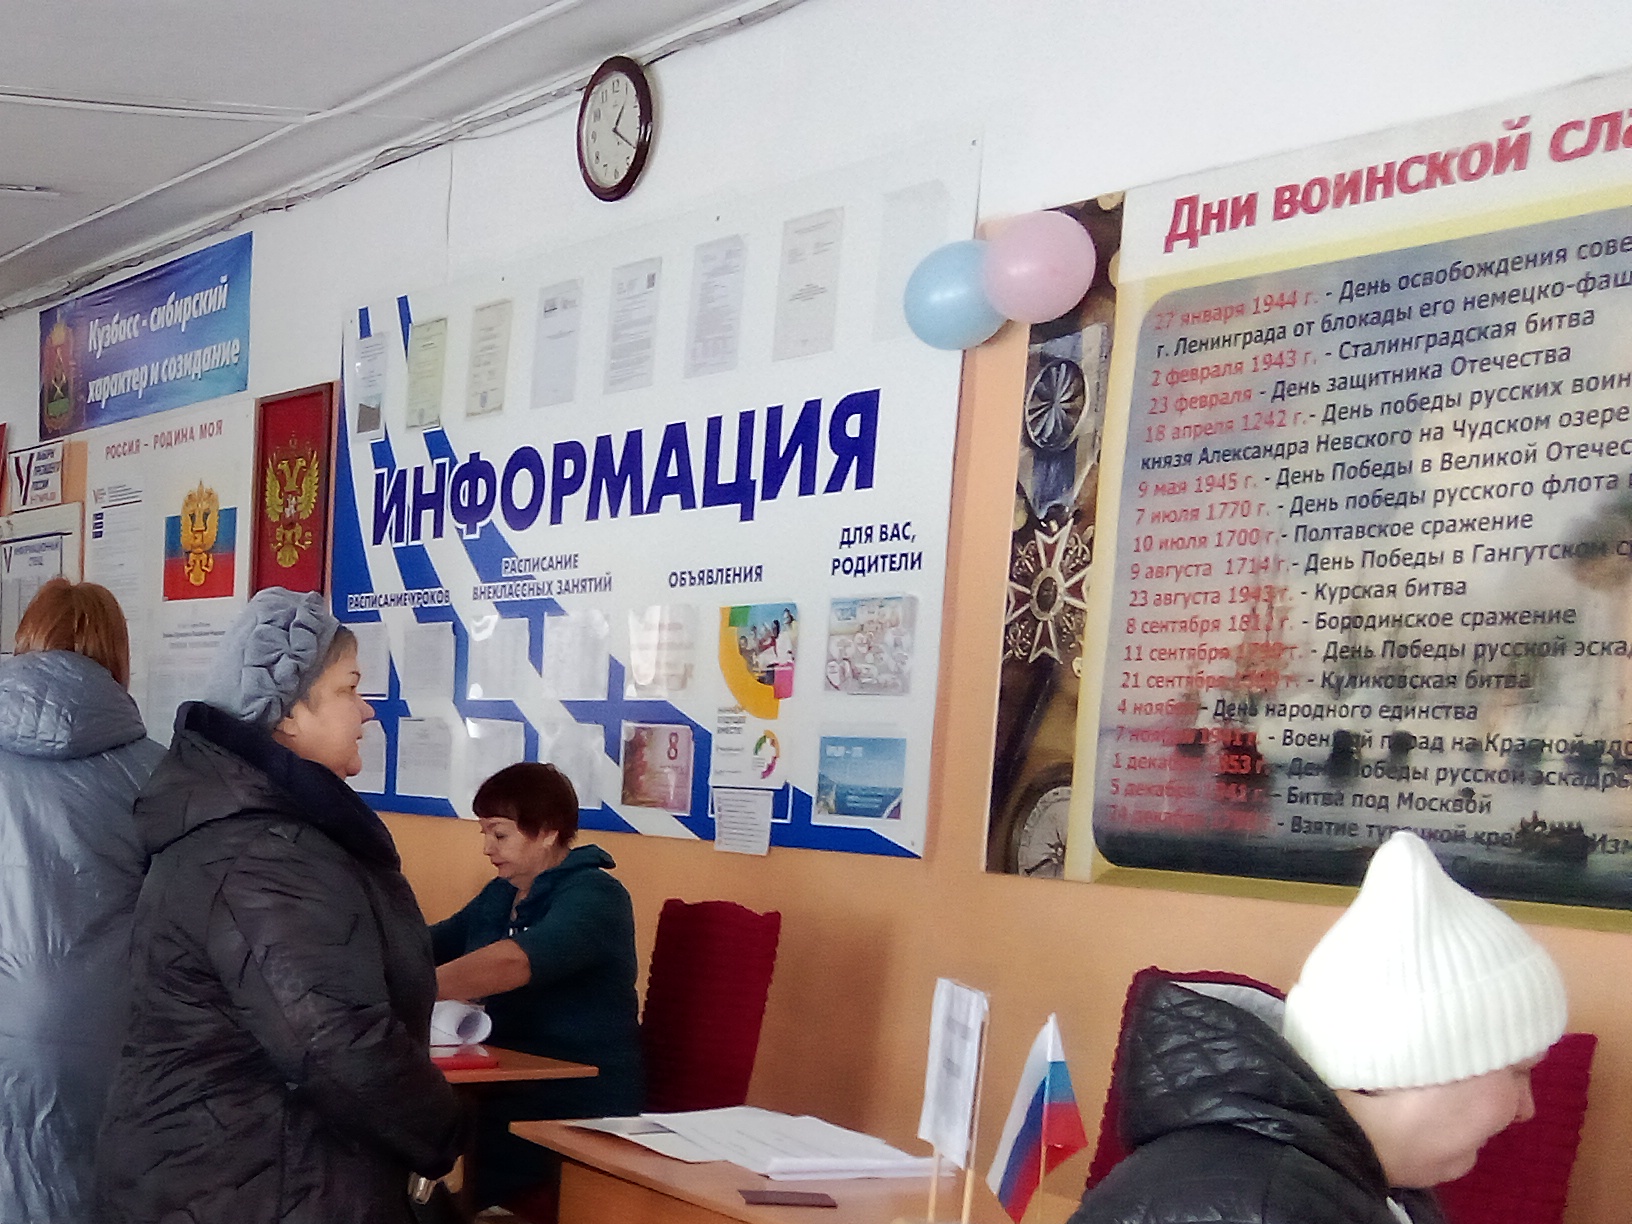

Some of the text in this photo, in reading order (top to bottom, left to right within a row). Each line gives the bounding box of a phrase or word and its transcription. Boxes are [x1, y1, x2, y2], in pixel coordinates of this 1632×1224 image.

[1163, 191, 1259, 254] Дни
[1272, 115, 1532, 221] воинской
[1180, 303, 1245, 325] января
[1252, 289, 1298, 315] 1944
[1338, 277, 1391, 304] День
[1398, 247, 1568, 292] освобождения
[88, 275, 229, 359] Кузбасс сибирский
[1156, 344, 1169, 359] г.
[1173, 326, 1287, 357] Ленинграда
[1293, 320, 1315, 338] от
[1320, 304, 1412, 333] блокады
[1419, 298, 1456, 318] его
[1151, 370, 1161, 387] 2
[1165, 359, 1244, 388] февраля
[1252, 348, 1297, 373] 1943
[1338, 321, 1517, 360] Сталинградская
[1524, 308, 1595, 335] битва
[87, 338, 240, 409] характер и созидание
[1148, 346, 1572, 415] 23 февраля День защитника Отечества
[1145, 424, 1166, 443] 18
[1171, 419, 1235, 441] апреля
[1242, 409, 1287, 432] 1242
[1321, 402, 1373, 426] День
[1380, 391, 1462, 416] победы
[1469, 379, 1564, 411] русских
[105, 419, 223, 460] РОССИЯ РОДИНА МОЯ
[1140, 405, 1630, 471] князя Александра Невского на Чудском озере
[372, 388, 881, 547] ИНФОРМАЦИЯ
[1138, 481, 1148, 498] 9
[1153, 480, 1187, 496] мая
[1194, 472, 1238, 494] 1945
[1276, 467, 1325, 490] День
[1331, 459, 1413, 482] Победы
[1421, 457, 1432, 473] в
[1439, 441, 1537, 472] Великой
[1135, 508, 1145, 525] 7
[1150, 507, 1200, 524] июля
[1206, 500, 1251, 521] 1770
[1289, 495, 1338, 518] День
[1345, 488, 1426, 511] победы
[1432, 480, 1534, 508] русского
[1542, 473, 1619, 500] флота
[839, 521, 916, 549] ДЛЯ ВАС,
[1133, 536, 1153, 553] 10
[1159, 535, 1208, 551] июля
[1294, 521, 1414, 544] Полтавское
[1421, 511, 1534, 539] сражение
[504, 553, 579, 574] РАСПИСАНИЕ
[668, 564, 764, 588] ОБЪЯВЛЕНИЯ
[832, 551, 923, 577] РОДИТЕЛИ
[1130, 563, 1140, 581] 9
[1145, 561, 1213, 582] августа
[1225, 556, 1271, 575] 1714
[1304, 552, 1355, 575] День
[1361, 547, 1444, 570] Победы
[1452, 549, 1463, 565] в
[348, 589, 451, 611] РАСПИСАНИЕ УРОКОВ
[472, 572, 613, 601] ВНЕКЛАССНЫХ ЗАНЯТИЙ
[1129, 590, 1148, 607] 23
[1152, 588, 1221, 609] августа
[1314, 581, 1397, 604] Курская
[1404, 577, 1467, 598] битва
[1126, 617, 1136, 635] 8
[1140, 614, 1221, 638] сентября
[1315, 610, 1454, 632] Бородинское
[1461, 608, 1577, 632] сражение
[1123, 645, 1143, 661] 11
[1148, 643, 1231, 664] сентября
[1323, 641, 1374, 662] День
[1381, 638, 1466, 660] Победы
[1473, 635, 1566, 662] русской
[1121, 672, 1141, 689] 21
[1320, 670, 1458, 695] Куликовская
[1465, 669, 1533, 689] битва
[1118, 699, 1127, 714] 4
[1213, 699, 1259, 718] День
[1265, 701, 1372, 722] народного
[1378, 704, 1478, 722] единства
[667, 732, 679, 760] 8
[1352, 793, 1390, 812] под
[1397, 790, 1493, 814] Москвой
[1291, 815, 1359, 837] Взятие
